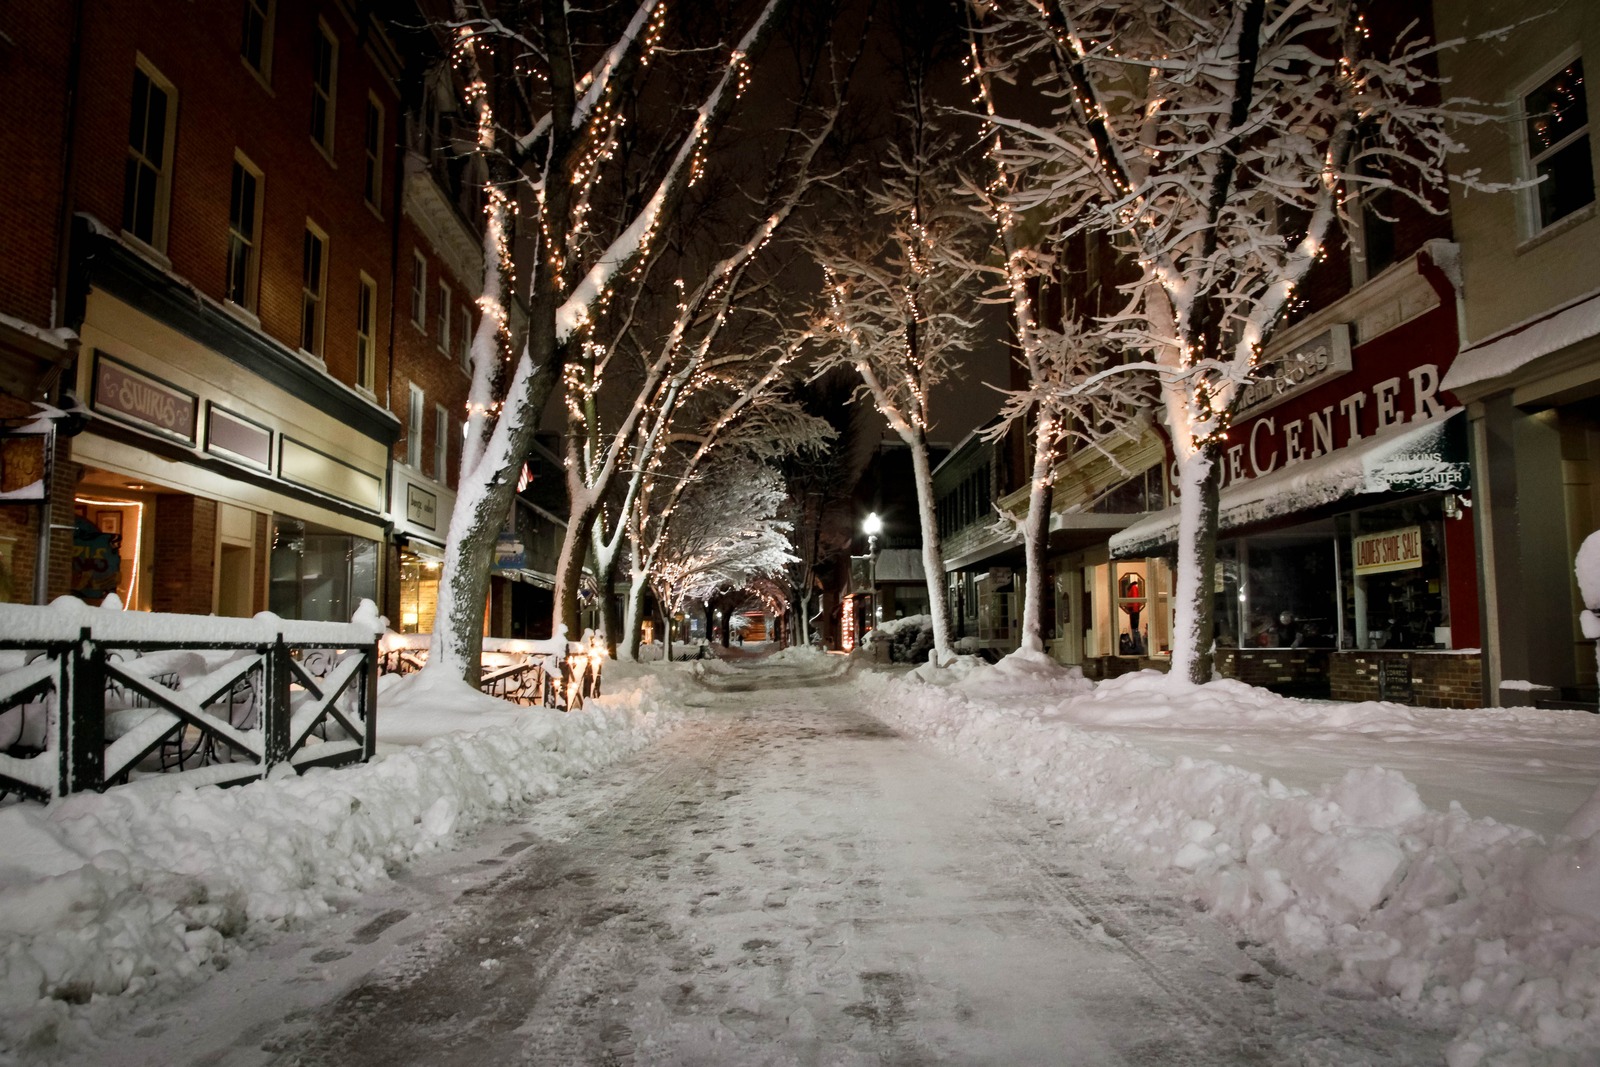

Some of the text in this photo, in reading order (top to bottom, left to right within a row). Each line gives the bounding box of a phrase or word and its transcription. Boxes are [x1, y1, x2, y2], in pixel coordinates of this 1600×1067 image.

[119, 378, 175, 427] SWIRLS
[1249, 363, 1447, 480] CENTER
[1414, 471, 1463, 484] CENTER
[1356, 531, 1419, 567] LADIES' SHOE SALE
